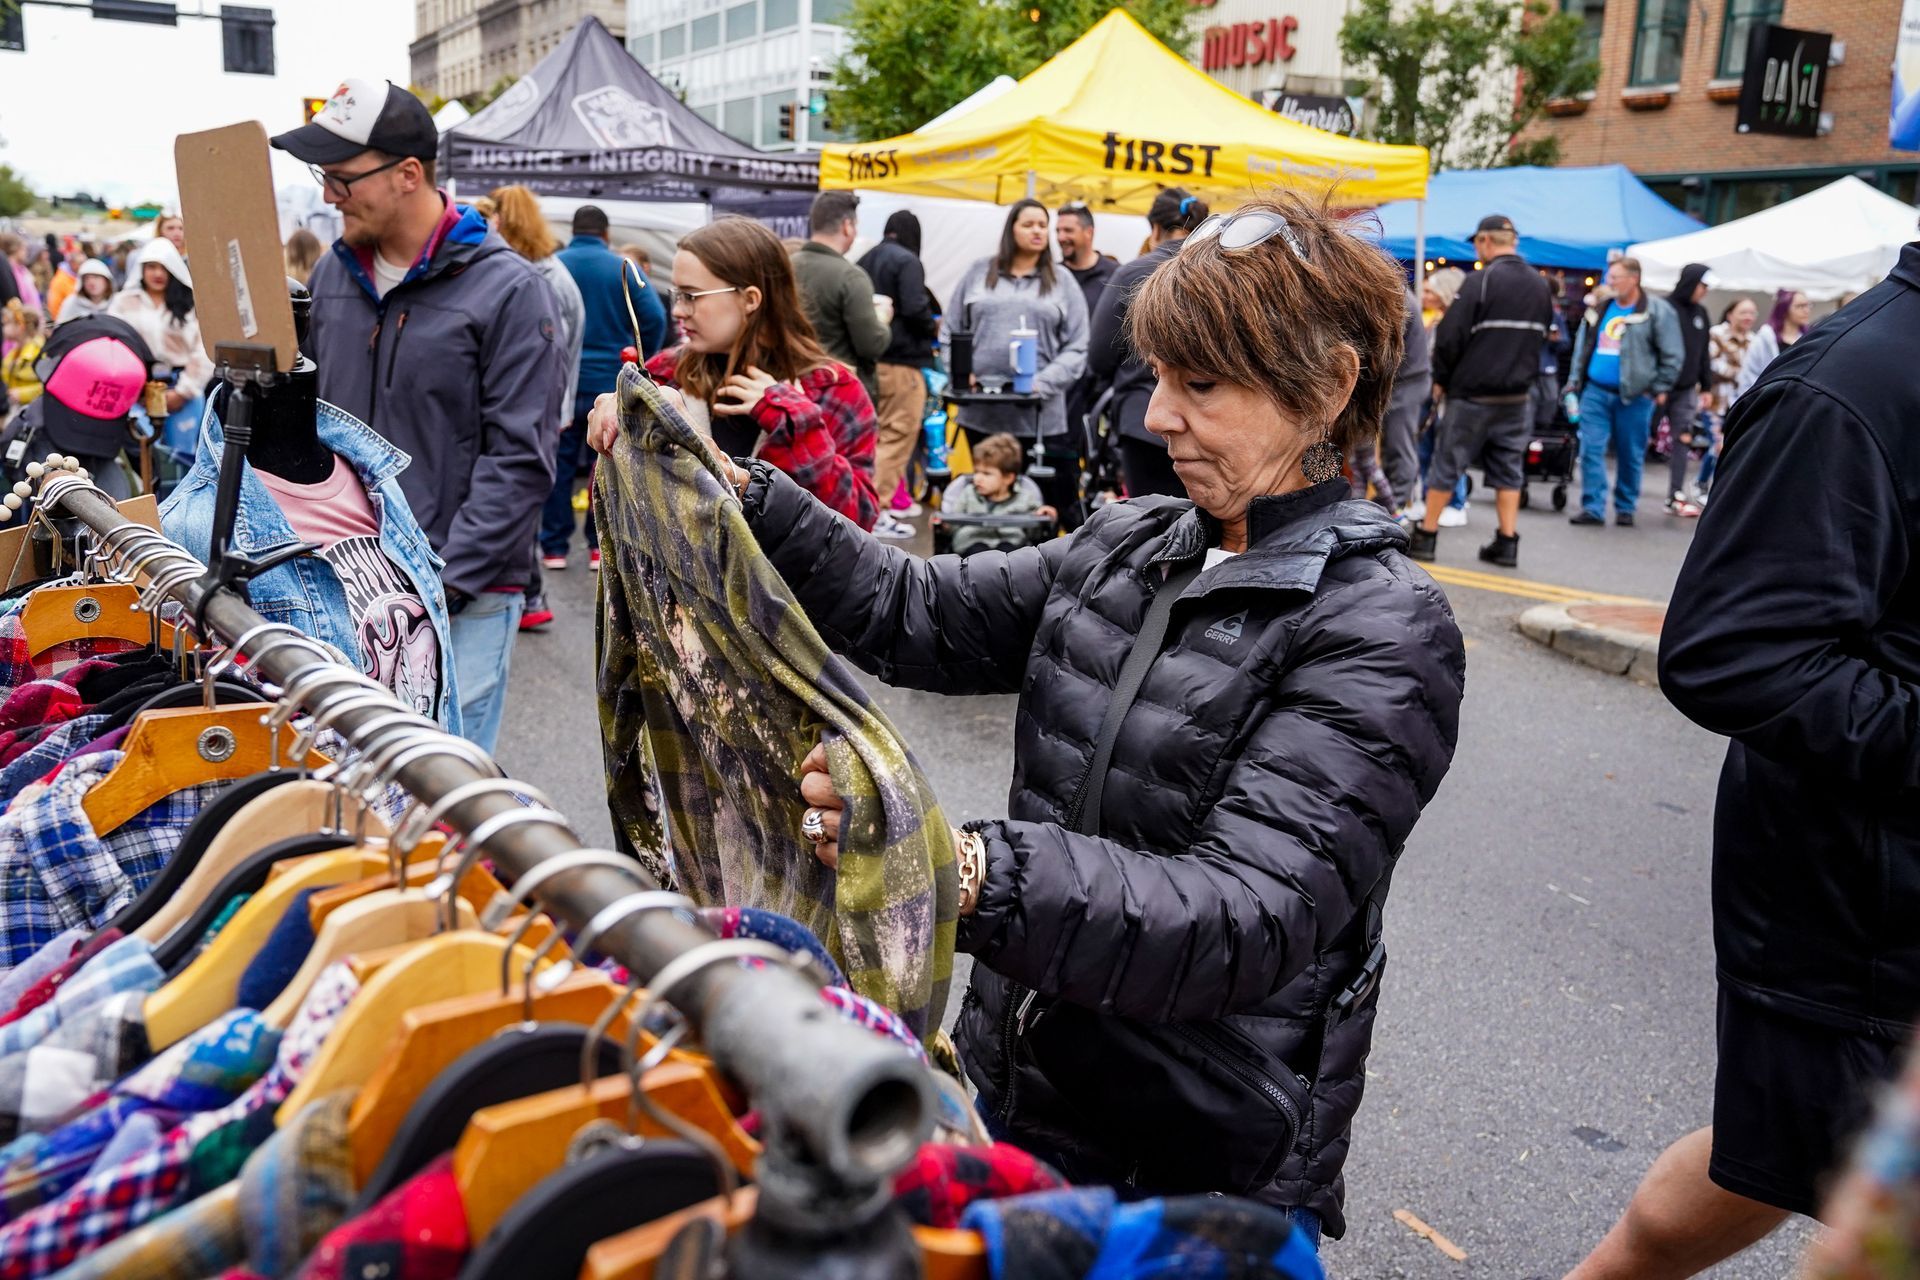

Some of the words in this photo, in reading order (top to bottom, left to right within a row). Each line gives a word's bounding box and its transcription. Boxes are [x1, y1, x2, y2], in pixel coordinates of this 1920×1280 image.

[1203, 15, 1298, 70] MUSIC
[588, 149, 715, 176] INTEGRITY
[1204, 628, 1238, 646] GERRY
